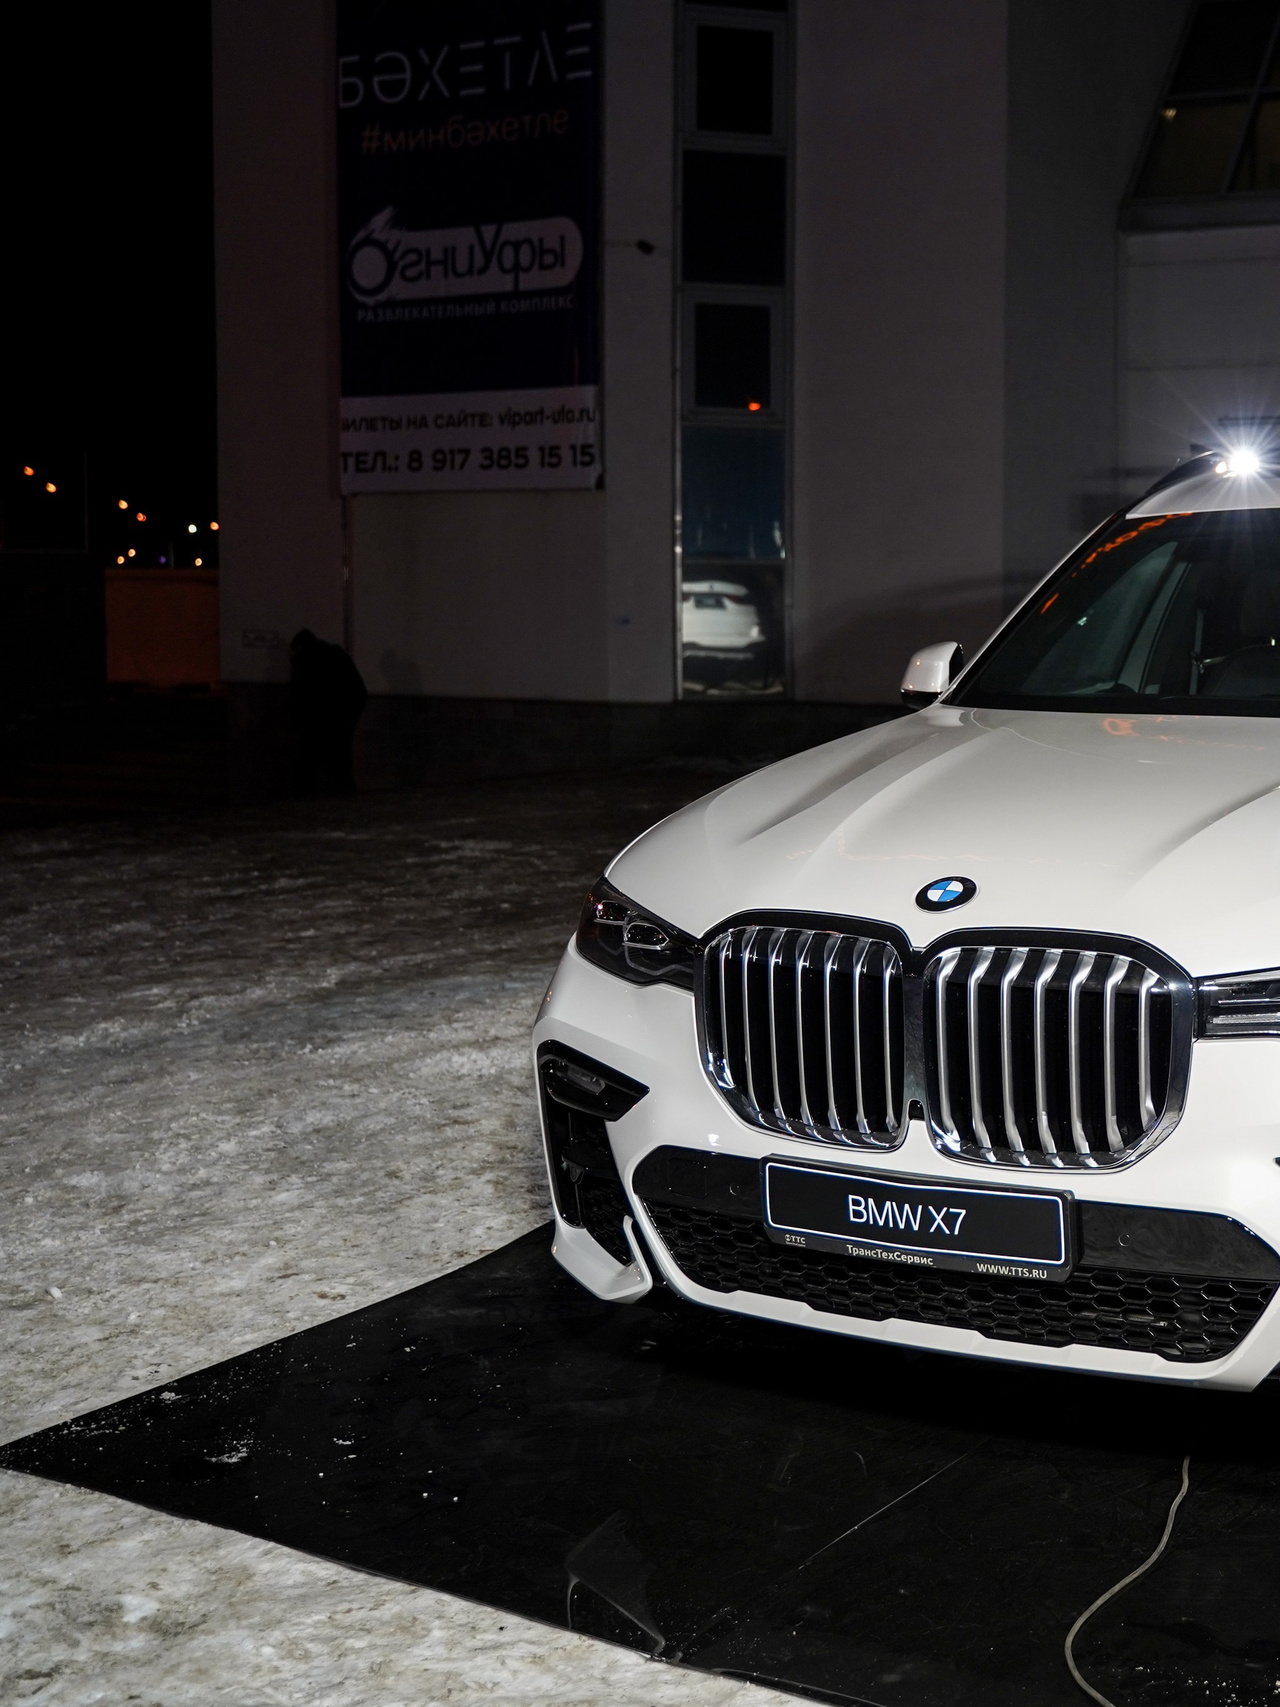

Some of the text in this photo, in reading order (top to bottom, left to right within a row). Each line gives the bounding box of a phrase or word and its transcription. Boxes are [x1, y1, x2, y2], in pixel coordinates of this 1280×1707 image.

[356, 297, 497, 323] РАЗВЛЕКАТЕЛЬНЫЙ
[407, 414, 428, 429] НА
[434, 410, 493, 429] САЙТЕ:
[499, 404, 596, 431] vipart-ufa.ru
[341, 443, 595, 473] ТЕЛ.: 8 917 385 15 15
[848, 1194, 966, 1235] BMW X7
[846, 1244, 934, 1266] ТрансТехСервис
[976, 1262, 1048, 1279] WWW.TTS.RU
